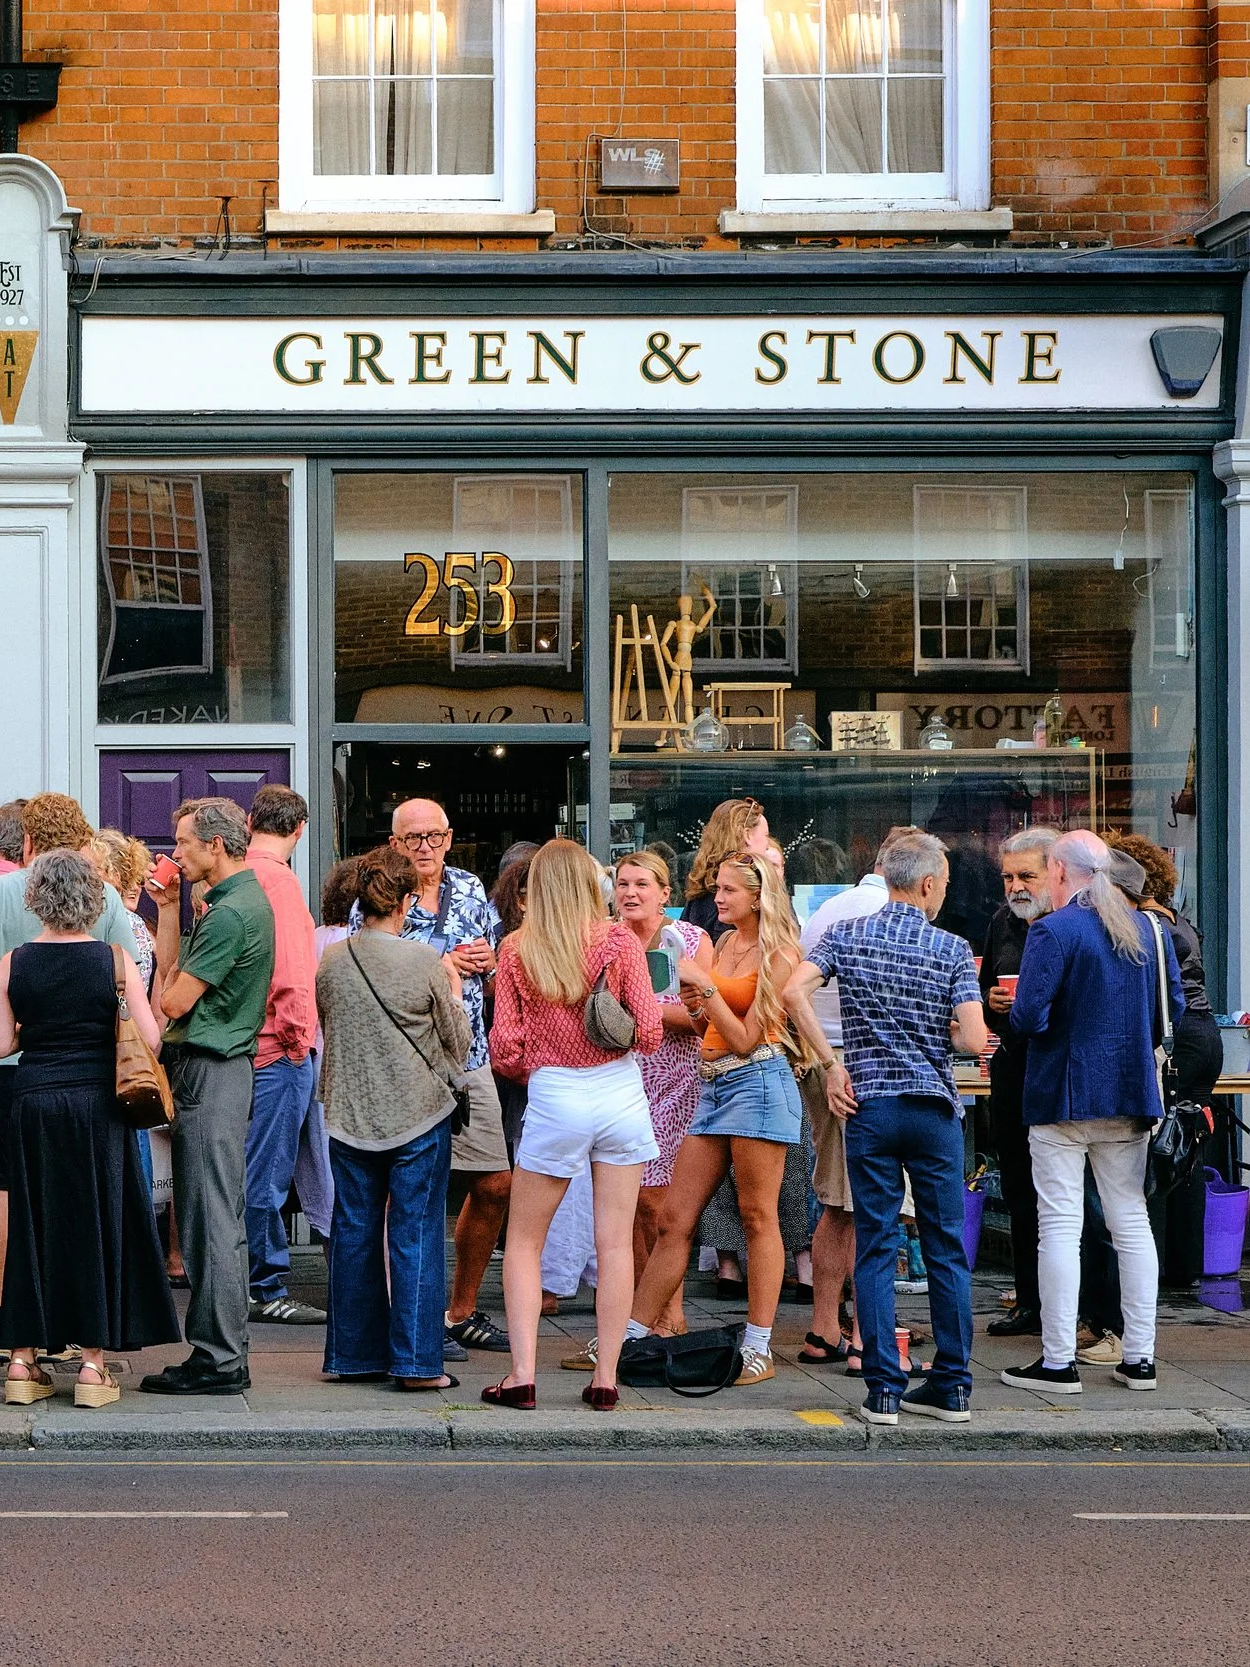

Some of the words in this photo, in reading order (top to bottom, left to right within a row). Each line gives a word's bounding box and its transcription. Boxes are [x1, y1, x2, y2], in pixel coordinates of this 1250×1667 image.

[272, 329, 586, 387] GREEN
[639, 330, 702, 386] &
[754, 328, 1062, 386] STONE
[403, 551, 519, 637] 253
